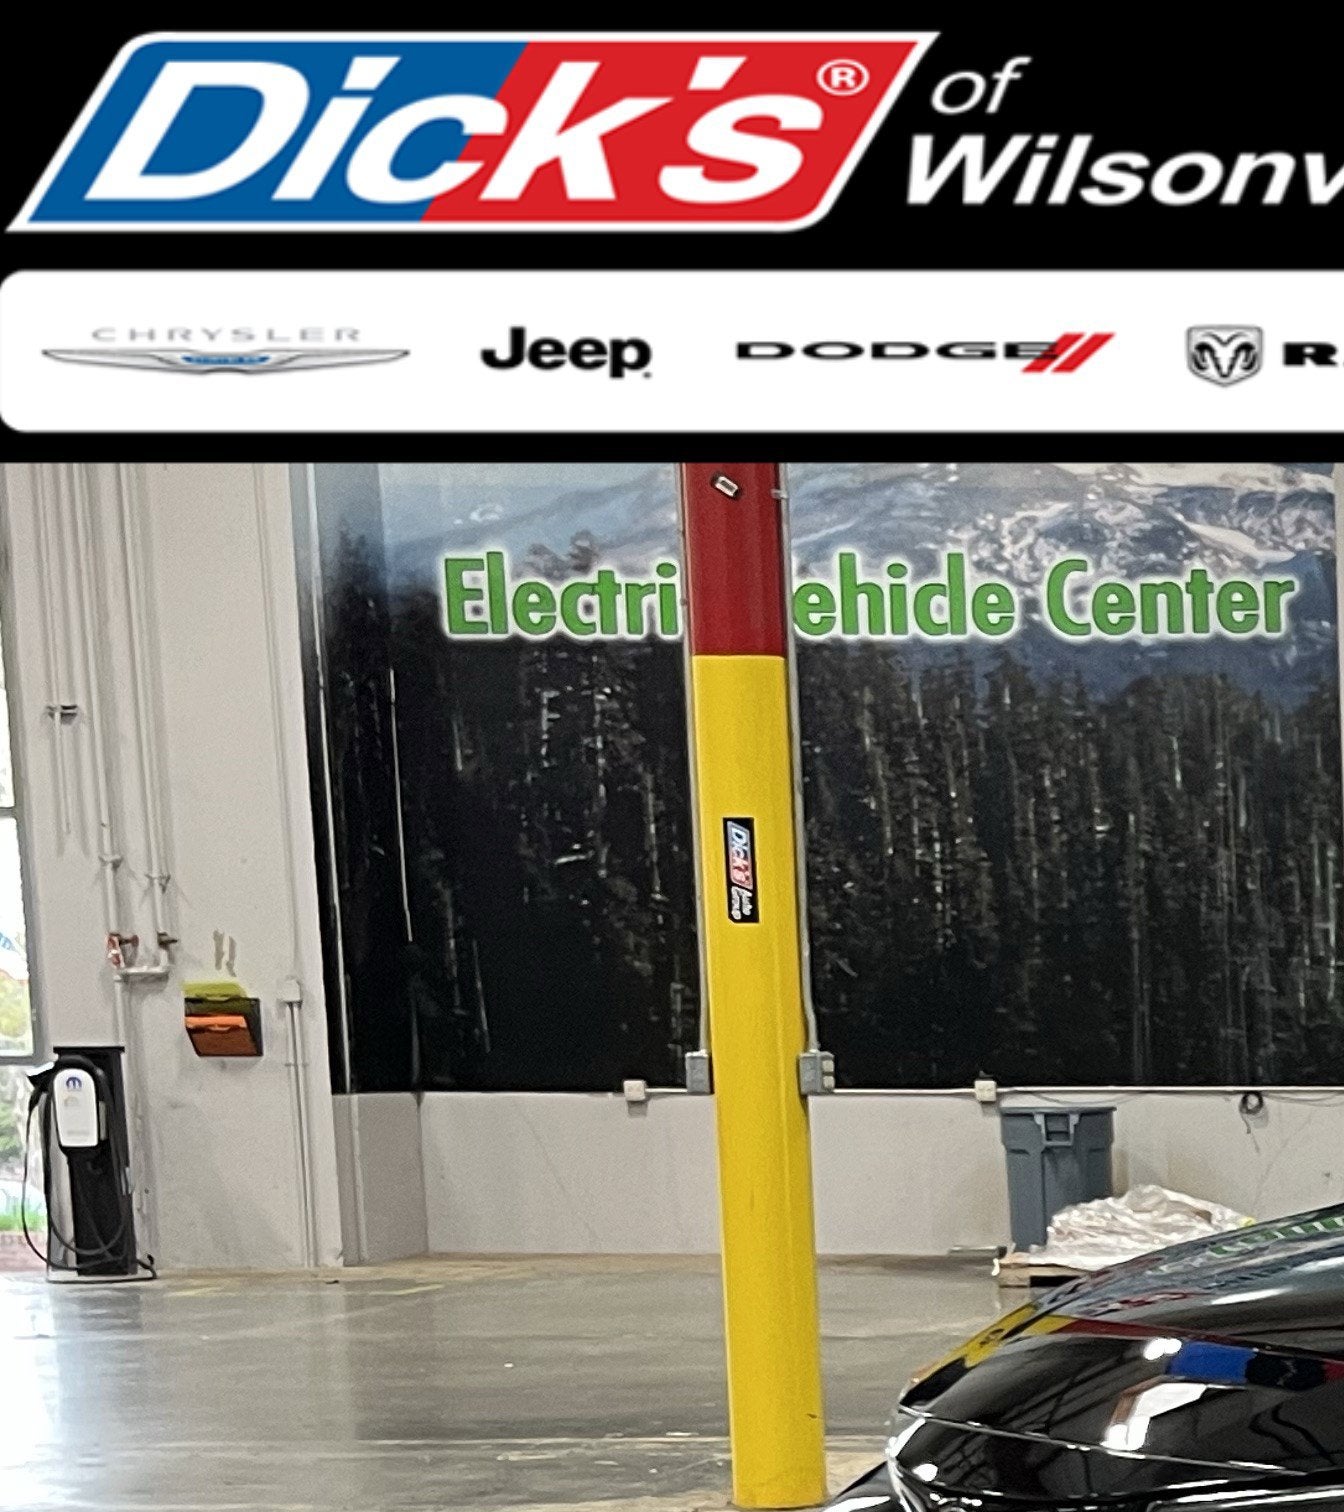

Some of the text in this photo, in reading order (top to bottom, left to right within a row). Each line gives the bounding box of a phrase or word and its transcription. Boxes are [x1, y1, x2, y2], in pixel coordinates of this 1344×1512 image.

[445, 552, 1295, 635] Electri ehicle Center
